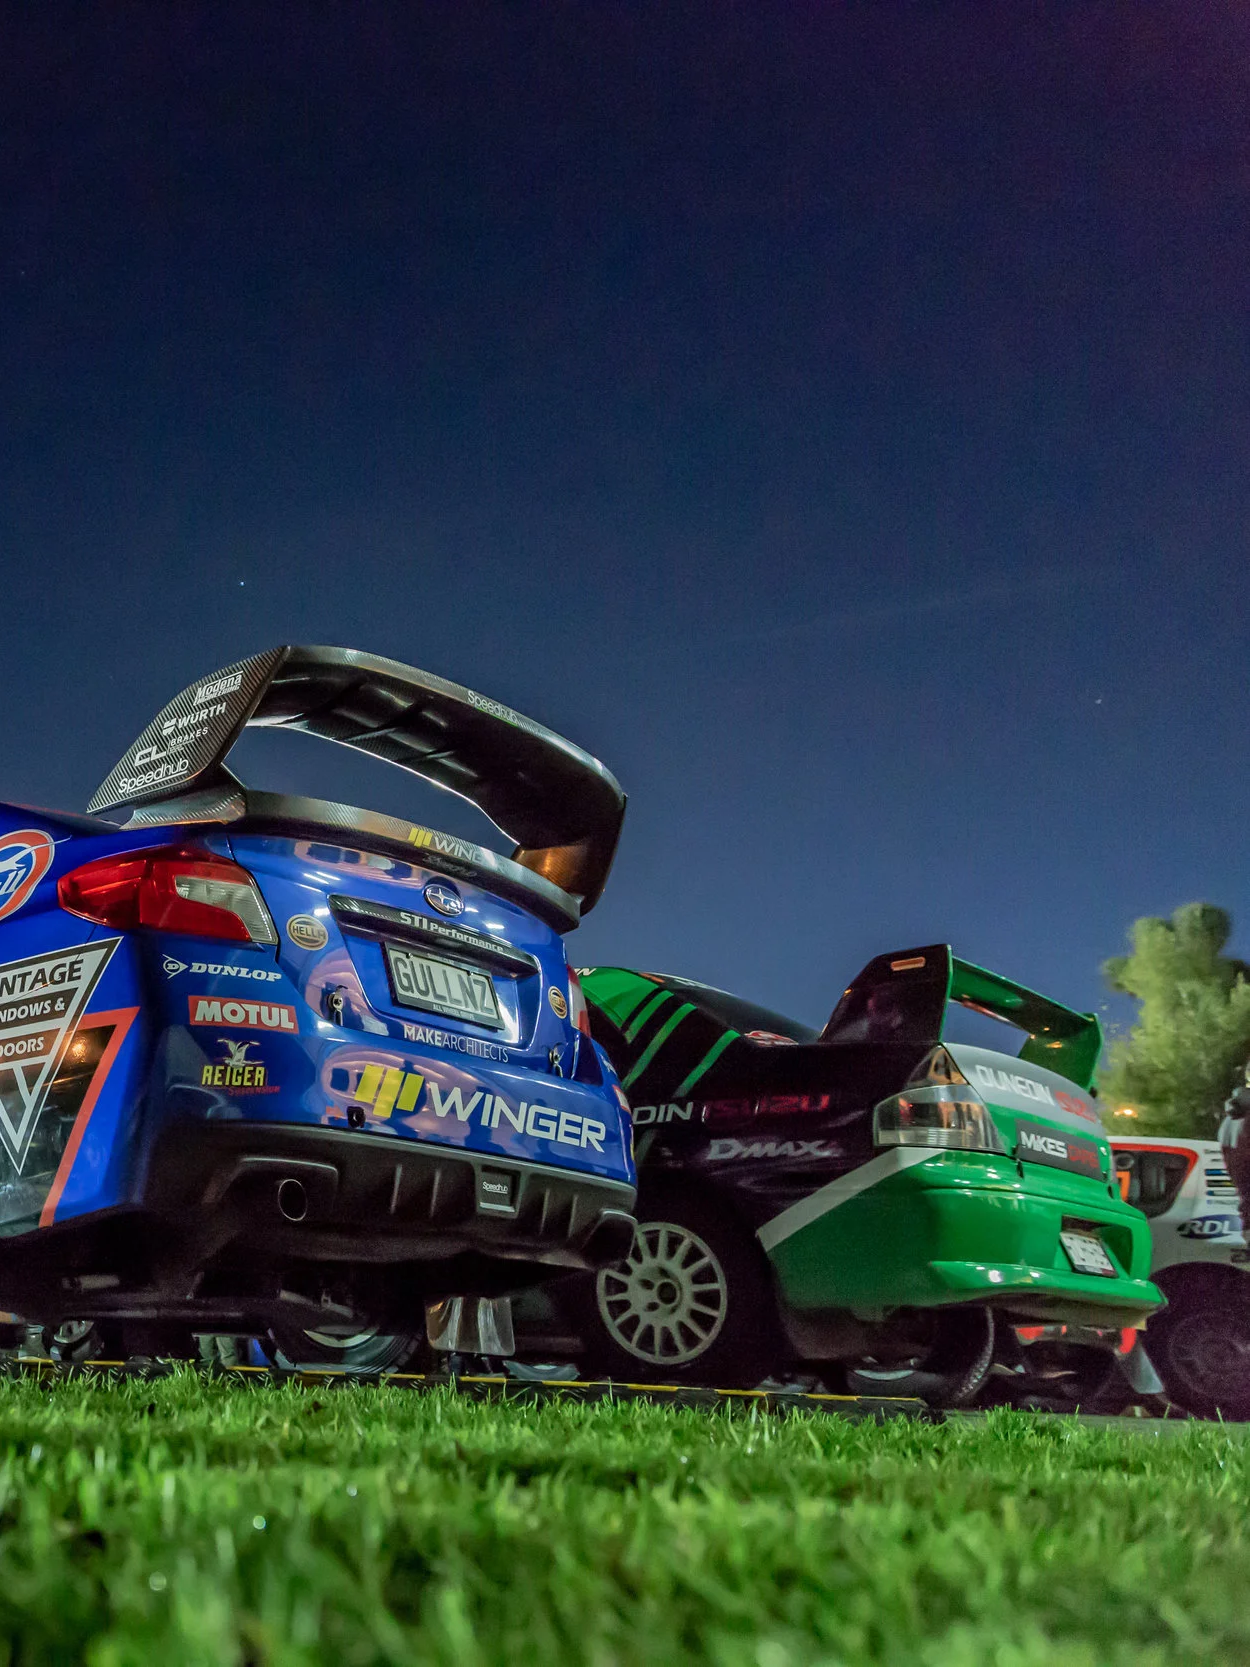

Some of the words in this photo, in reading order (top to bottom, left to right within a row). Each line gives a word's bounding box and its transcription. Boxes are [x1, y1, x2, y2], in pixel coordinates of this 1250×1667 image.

[197, 674, 243, 699] Modena
[467, 689, 519, 727] Speedhub
[171, 727, 209, 747] BRAKES
[118, 758, 189, 794] Speedhub
[434, 834, 486, 865] WING
[292, 925, 326, 941] HELLA
[400, 911, 428, 932] STI
[430, 921, 504, 952] Performance
[189, 962, 282, 982] DUNLOP
[393, 957, 495, 1016] GULLNZ
[55, 997, 66, 1012] &
[195, 1000, 295, 1029] MOTUL
[202, 1065, 265, 1087] REIGER
[429, 1080, 608, 1154] WINGER
[482, 1181, 508, 1194] Speedhub
